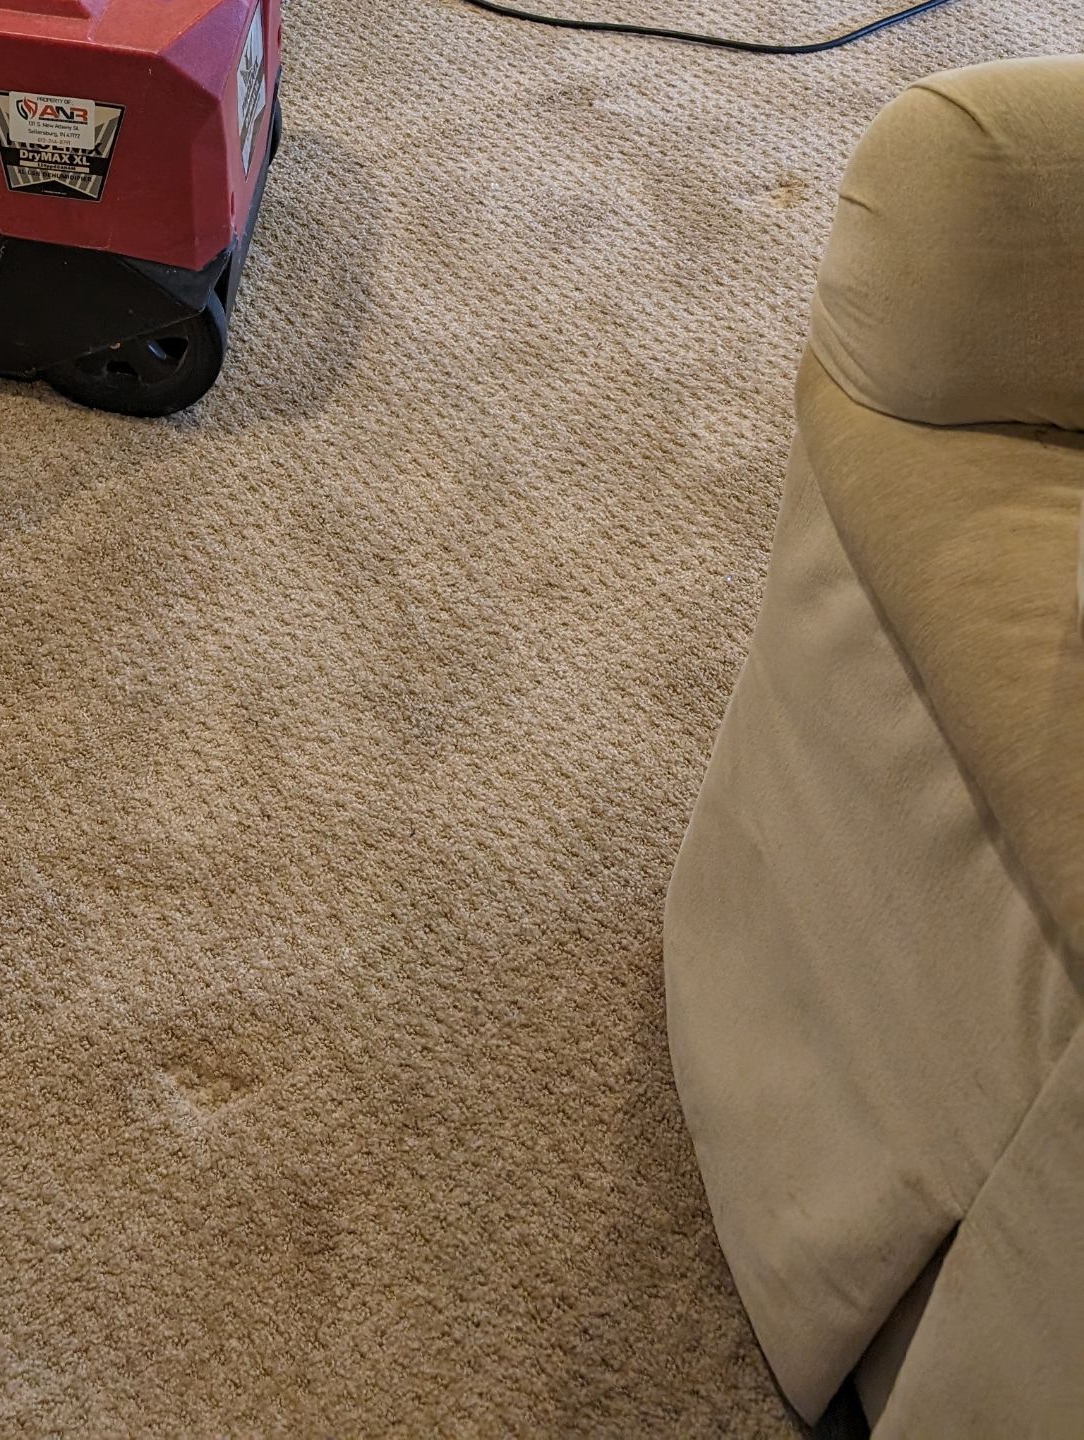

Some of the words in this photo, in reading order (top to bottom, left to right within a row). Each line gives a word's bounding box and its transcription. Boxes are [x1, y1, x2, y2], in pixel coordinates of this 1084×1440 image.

[39, 104, 89, 122] ANR
[19, 149, 71, 164] DryMAX
[73, 155, 91, 166] XL
